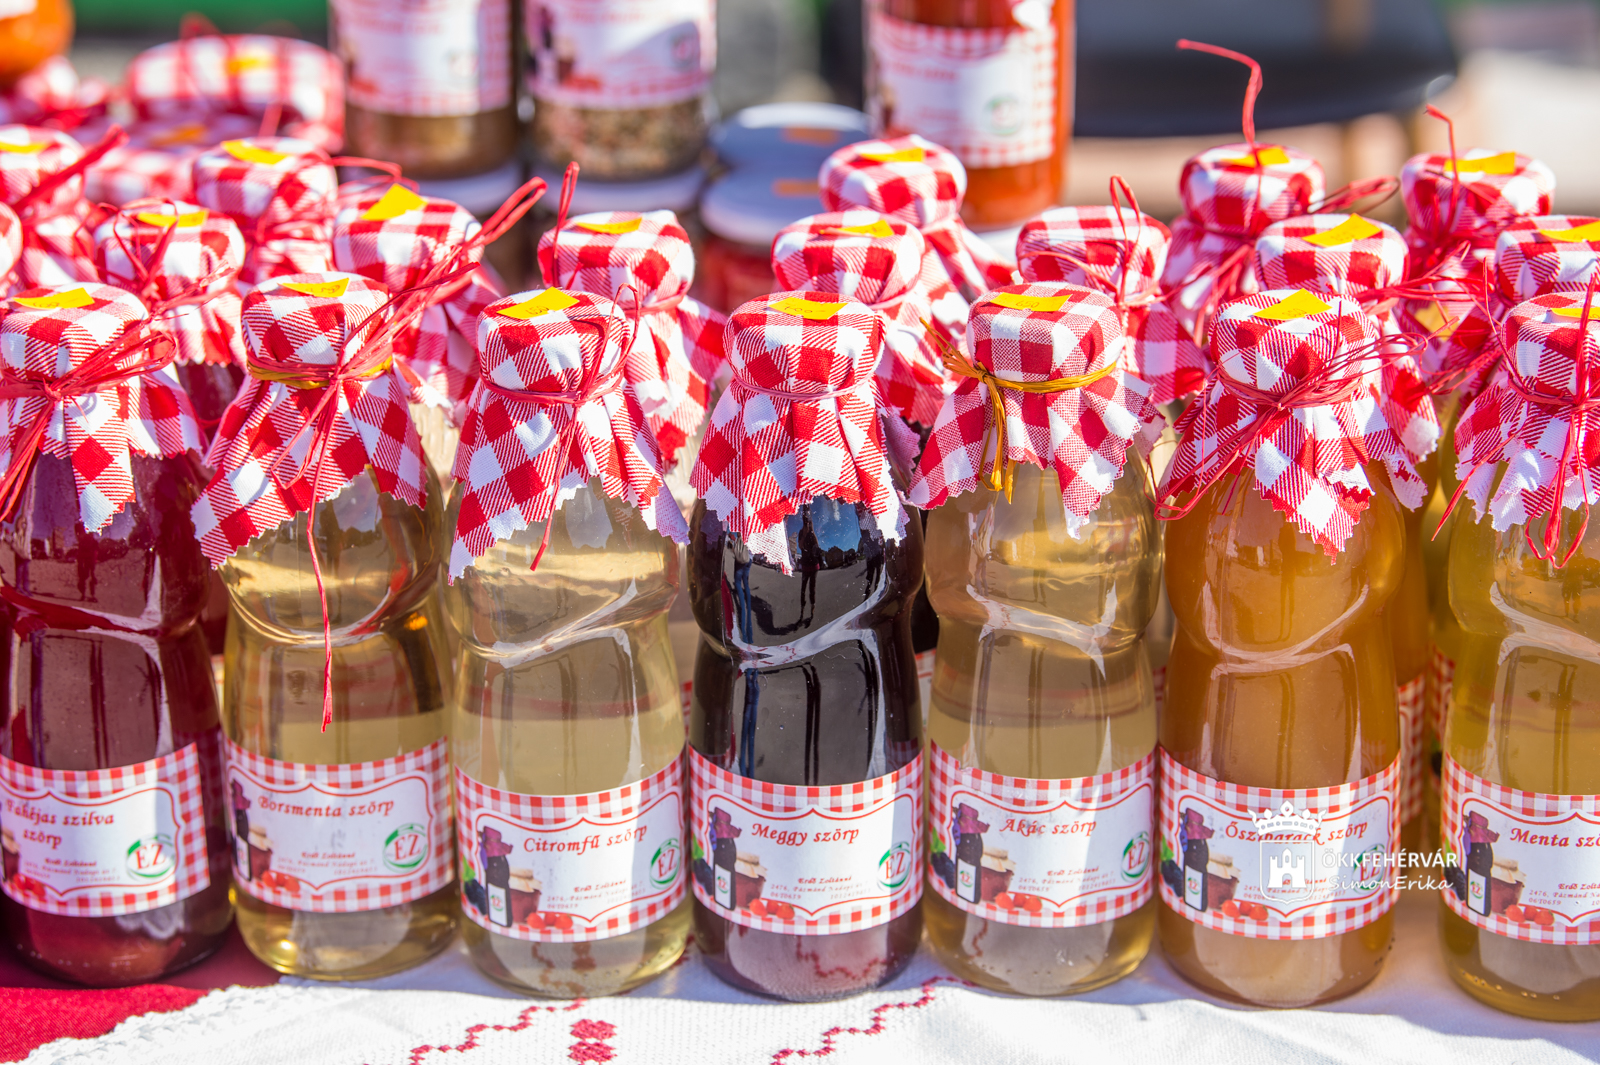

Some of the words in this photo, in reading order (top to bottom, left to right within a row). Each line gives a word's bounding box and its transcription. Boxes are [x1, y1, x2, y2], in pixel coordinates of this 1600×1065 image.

[257, 795, 342, 818] Borsmenta
[348, 799, 394, 817] szörp
[62, 811, 115, 826] szilva
[999, 818, 1046, 838] Akác
[1051, 820, 1097, 837] szörp
[751, 822, 808, 847] Meggy
[813, 828, 860, 845] szörp
[1327, 821, 1368, 842] szörp
[1510, 827, 1570, 848] Menta
[135, 843, 167, 870] EZ
[394, 832, 423, 863] EZ
[523, 834, 601, 856] Citromfű
[1127, 841, 1146, 872] EZ
[656, 847, 679, 880] EZ
[885, 850, 908, 880] EZ
[1558, 882, 1579, 891] Erdő
